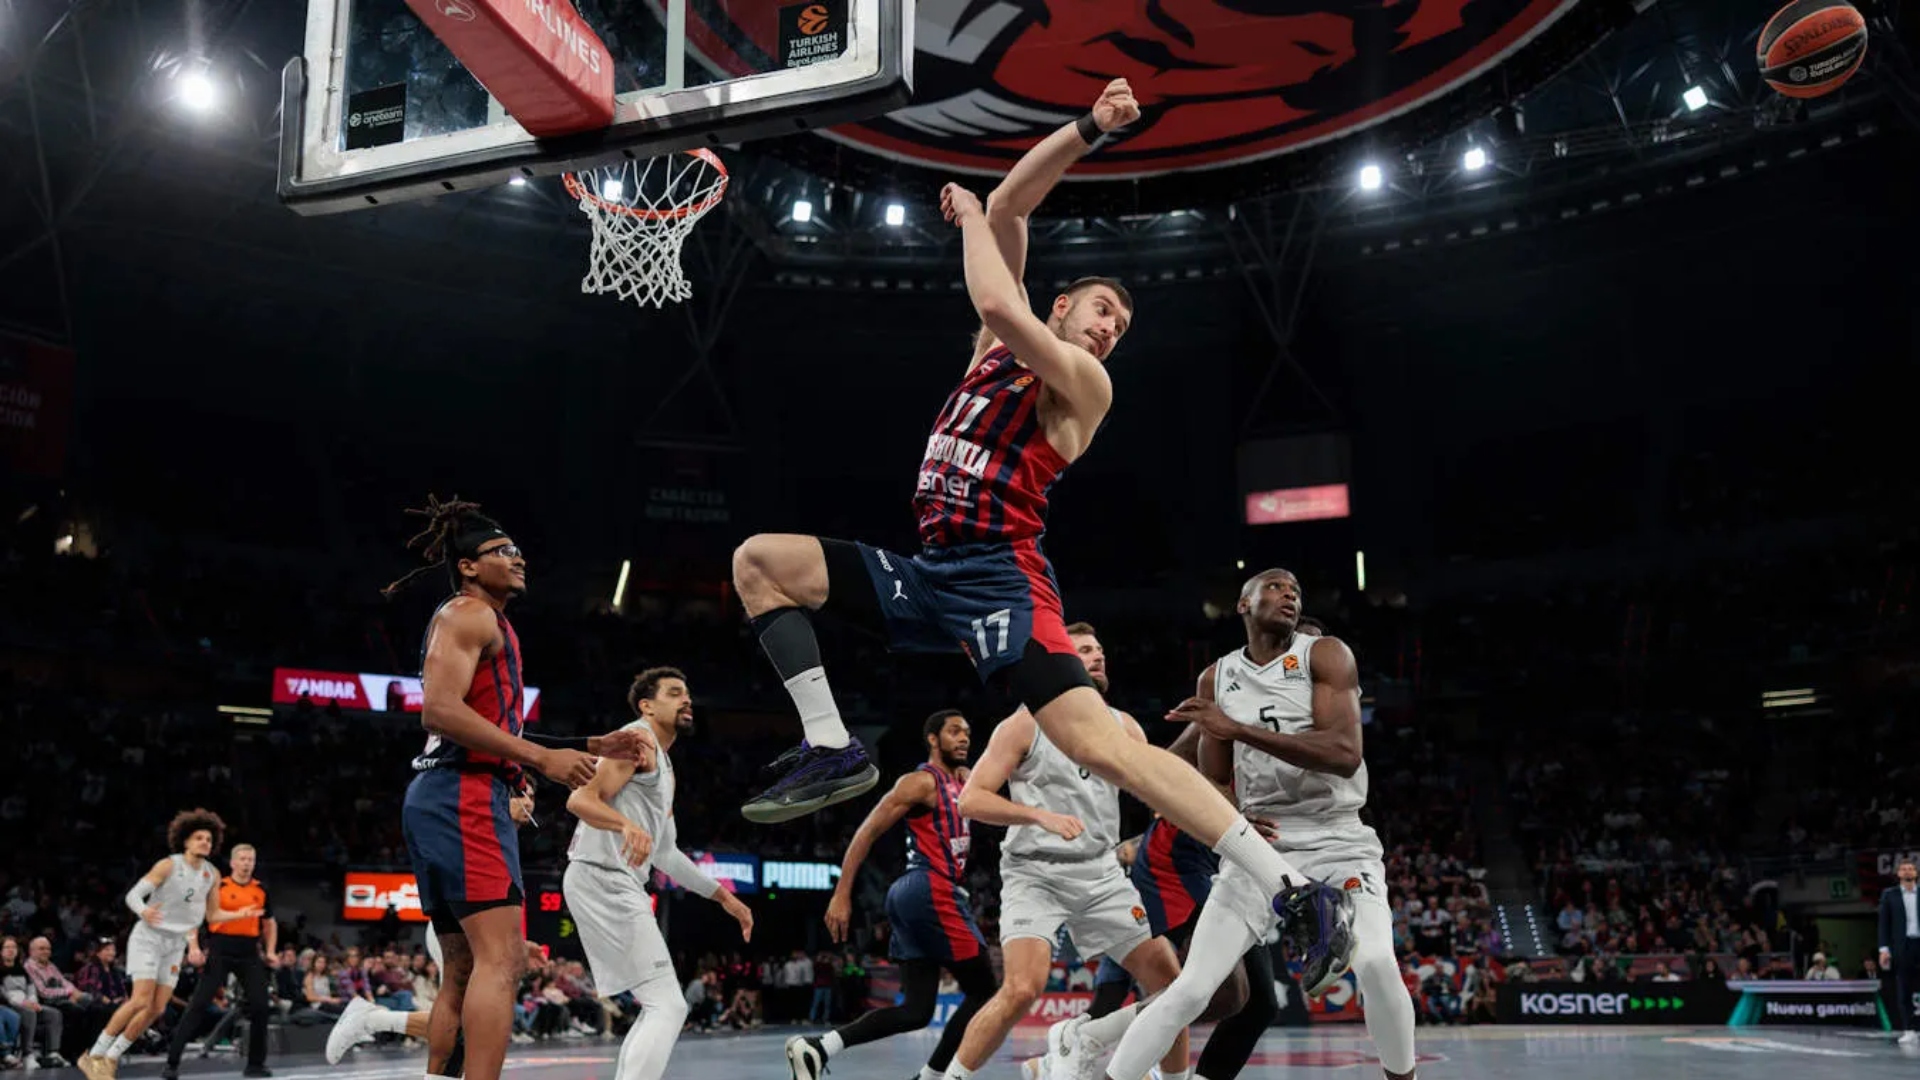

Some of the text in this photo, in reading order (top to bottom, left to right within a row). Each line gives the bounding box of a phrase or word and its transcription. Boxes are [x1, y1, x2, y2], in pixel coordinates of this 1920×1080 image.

[788, 41, 839, 59] AIRLINES
[789, 32, 838, 48] TURKISH
[971, 608, 1011, 660] 17
[300, 678, 356, 699] AMBAR
[1260, 705, 1280, 732] 5
[762, 861, 832, 889] PUMA
[184, 888, 195, 903] 2
[1521, 993, 1629, 1015] kosner
[1766, 1002, 1814, 1015] Nueva
